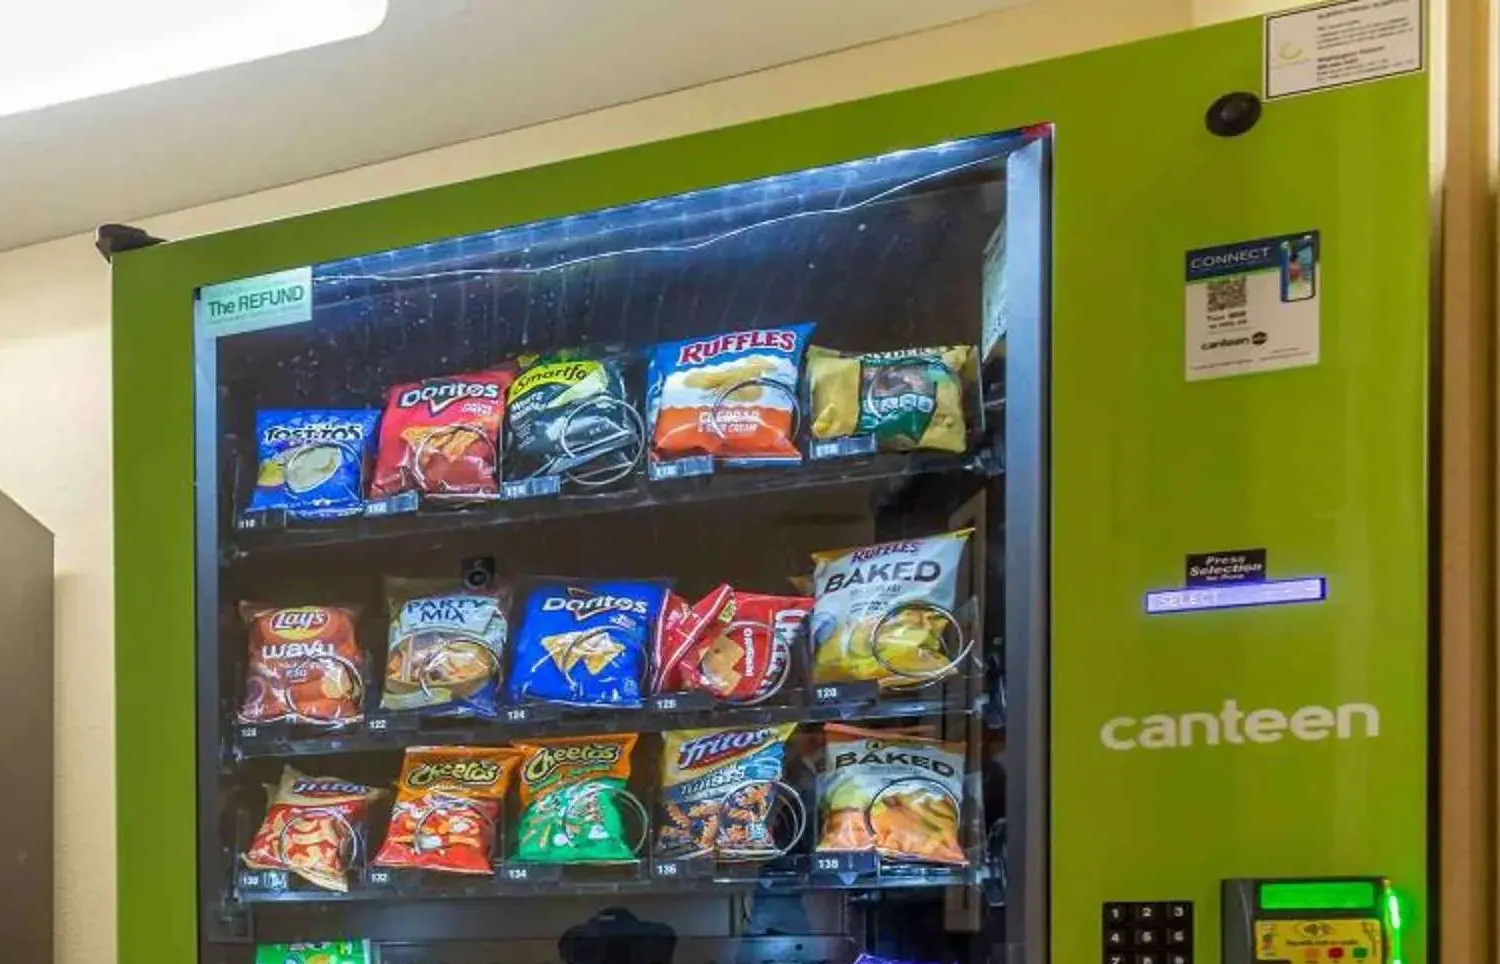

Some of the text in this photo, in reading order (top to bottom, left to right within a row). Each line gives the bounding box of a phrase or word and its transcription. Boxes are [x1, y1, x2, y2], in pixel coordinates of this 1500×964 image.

[1190, 247, 1270, 269] CONNECT
[207, 284, 305, 318] The REFUND
[679, 329, 796, 366] RUFFLES
[400, 382, 499, 408] Doritos
[1189, 563, 1262, 578] Selection
[1205, 555, 1247, 566] Press
[823, 559, 942, 594] BAKED
[419, 606, 467, 624] MIX
[542, 594, 649, 615] Doritos
[1100, 699, 1380, 751] canteen
[522, 744, 620, 784] Cheetos
[834, 751, 956, 777] BAKED
[1111, 907, 1185, 918] 1 2 3
[1111, 932, 1120, 943] 4
